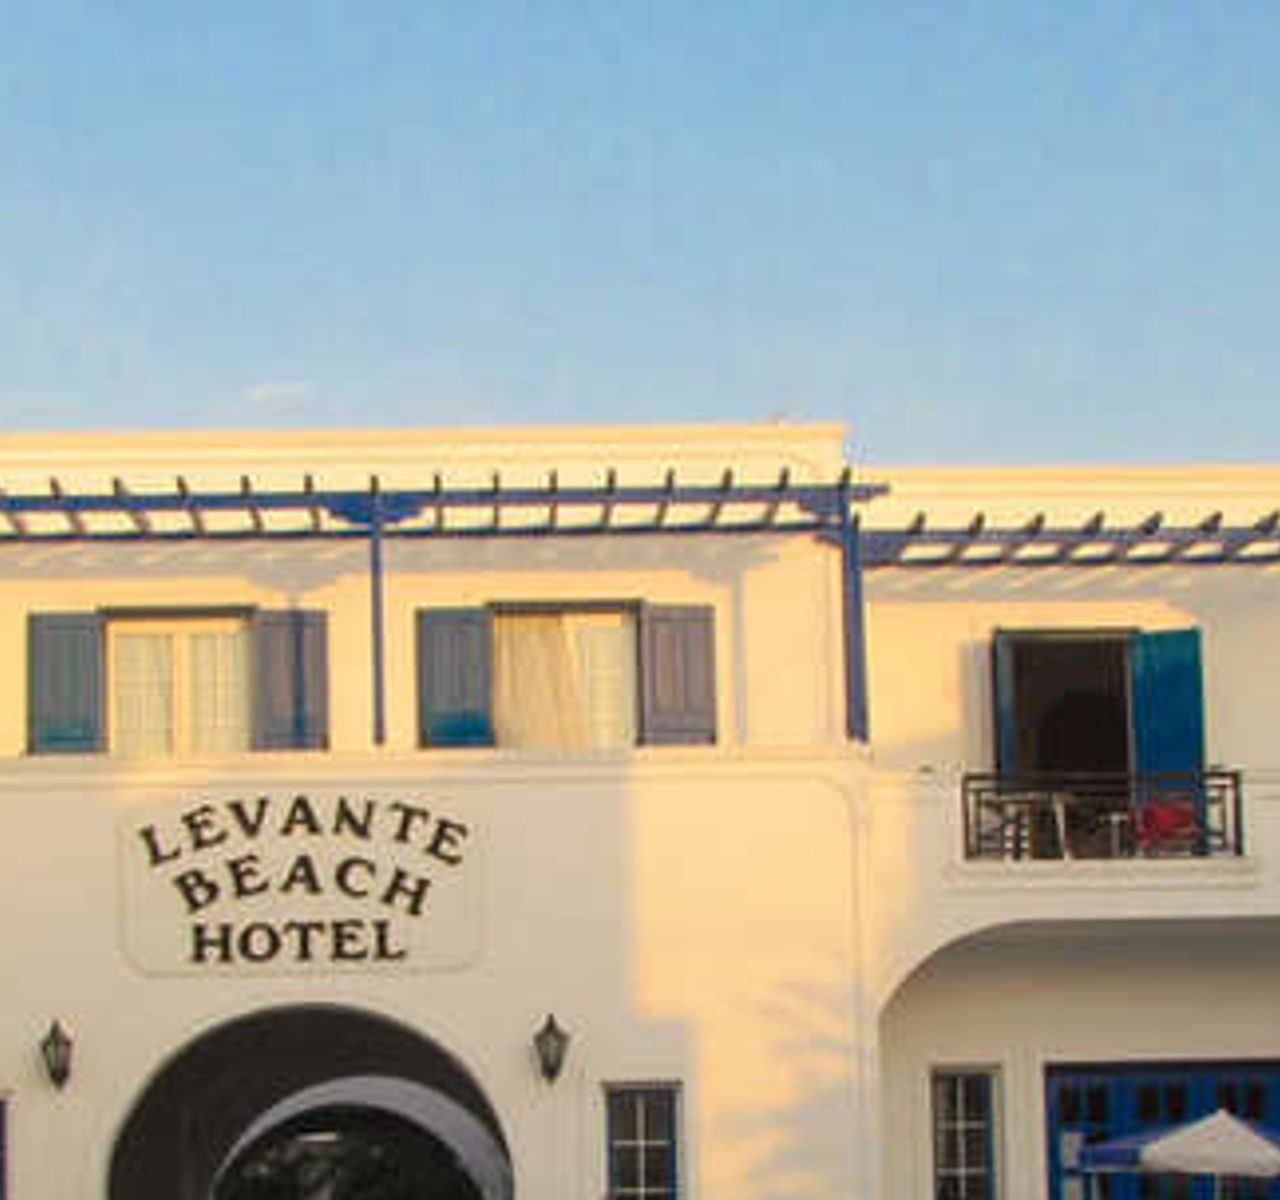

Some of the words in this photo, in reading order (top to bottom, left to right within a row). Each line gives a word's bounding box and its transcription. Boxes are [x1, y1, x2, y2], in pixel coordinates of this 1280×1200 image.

[139, 795, 468, 866] LEVANTE
[173, 854, 431, 916] BEACH
[190, 920, 407, 963] HOTEL
